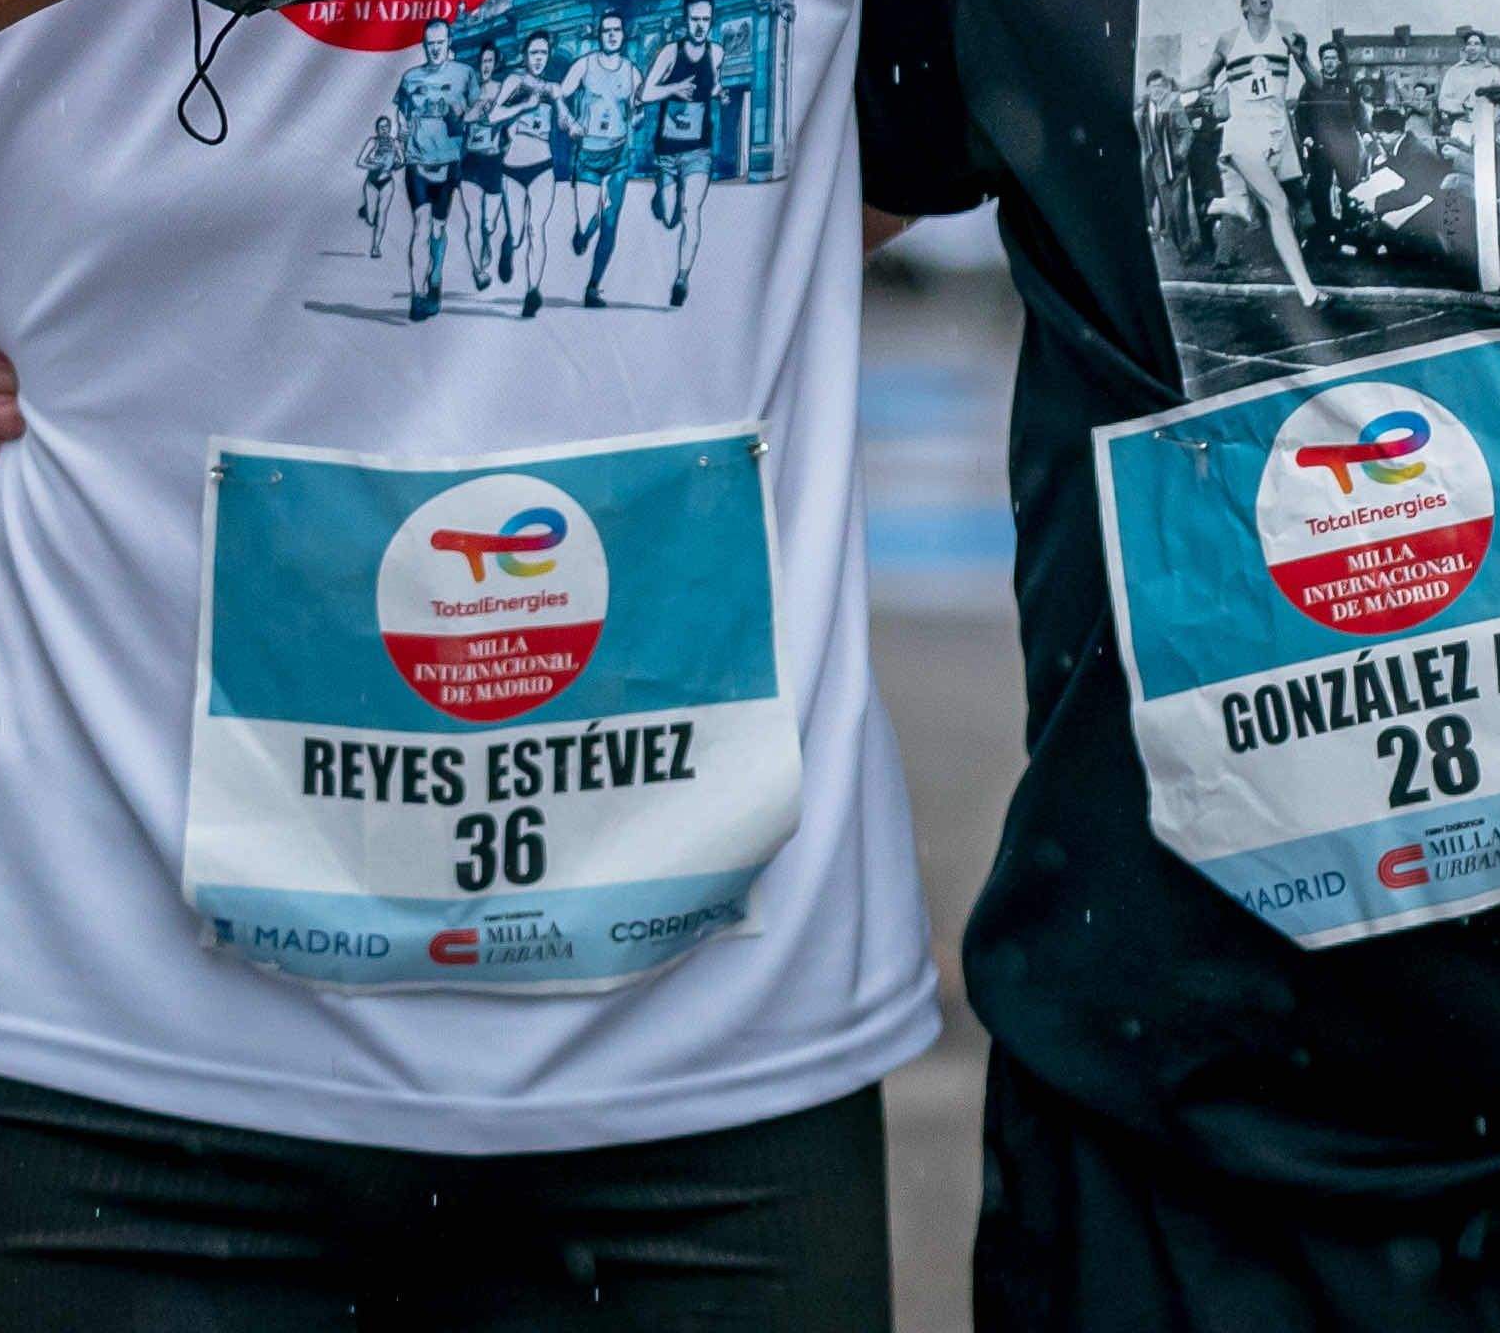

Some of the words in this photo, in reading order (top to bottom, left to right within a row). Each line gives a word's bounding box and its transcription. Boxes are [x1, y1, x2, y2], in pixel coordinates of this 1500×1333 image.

[354, 0, 453, 23] MADRID
[1251, 76, 1267, 95] 41
[1305, 492, 1448, 536] TotalEnergies
[1346, 542, 1416, 572] MILLA
[431, 589, 569, 617] TotalEnergies
[1331, 599, 1363, 622] DE
[1364, 579, 1451, 613] MADRID
[467, 635, 529, 660] MILLA
[440, 683, 472, 704] DE
[476, 675, 554, 702] MADRID
[1221, 639, 1481, 754] GONZÁLEZ
[302, 736, 467, 807] REYES
[486, 721, 697, 803] ESTÉVEZ
[1376, 712, 1482, 810] 28
[453, 804, 549, 893] 36
[255, 927, 391, 960] MADRID
[485, 919, 564, 945] MILLA
